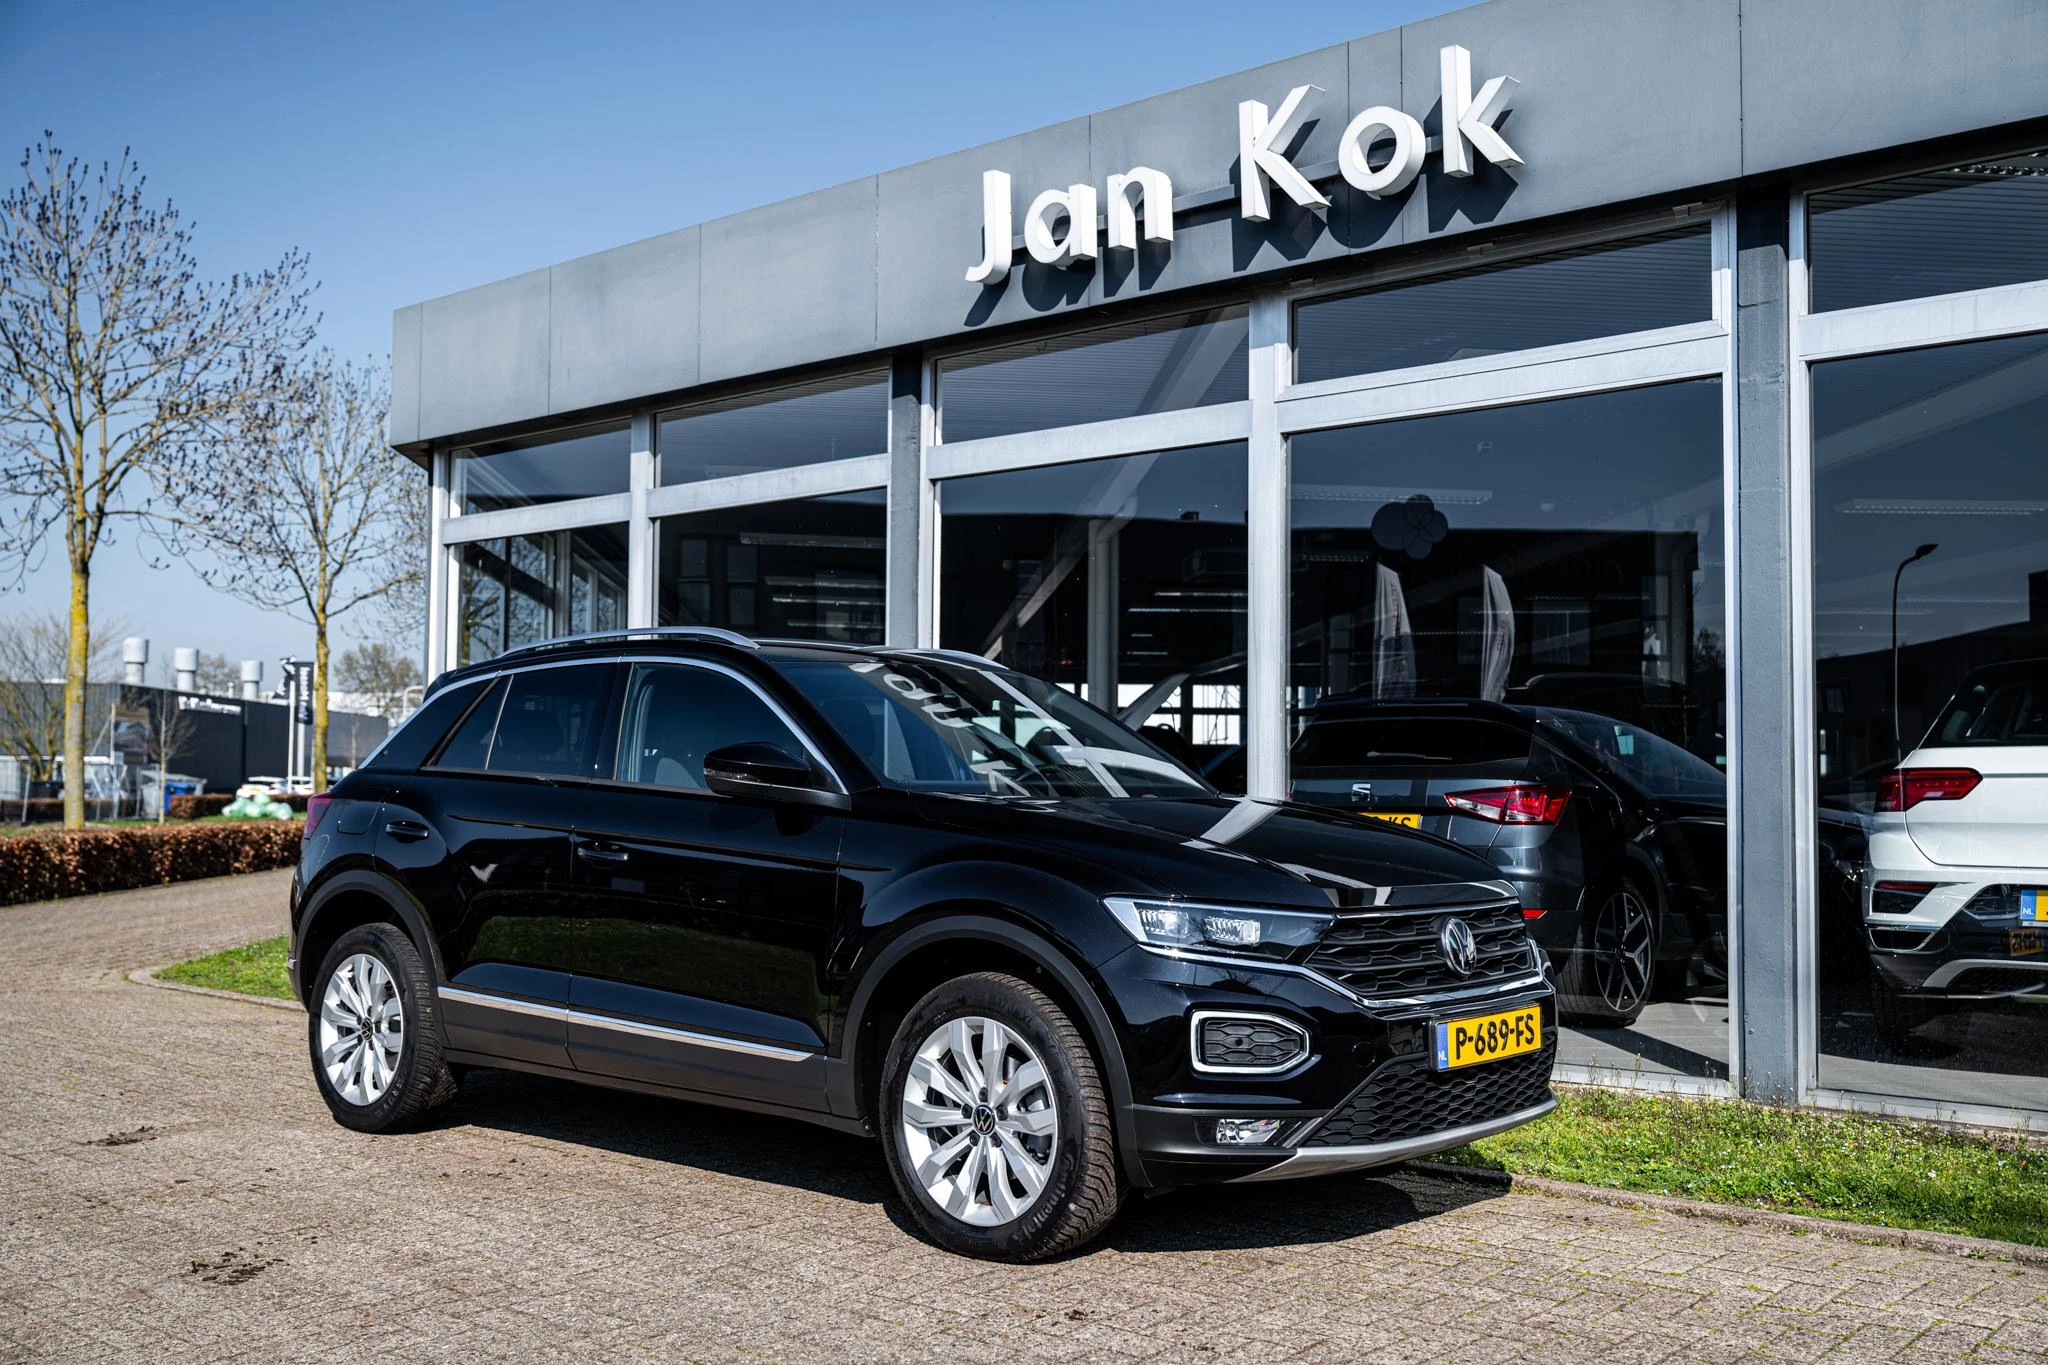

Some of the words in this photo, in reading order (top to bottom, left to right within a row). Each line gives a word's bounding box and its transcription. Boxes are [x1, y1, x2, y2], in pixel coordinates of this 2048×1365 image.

[965, 166, 1174, 286] Jan
[1238, 44, 1526, 223] Kok
[2022, 907, 2035, 915] NL
[1455, 1013, 1535, 1061] P-689-FS
[1438, 1050, 1448, 1061] NL
